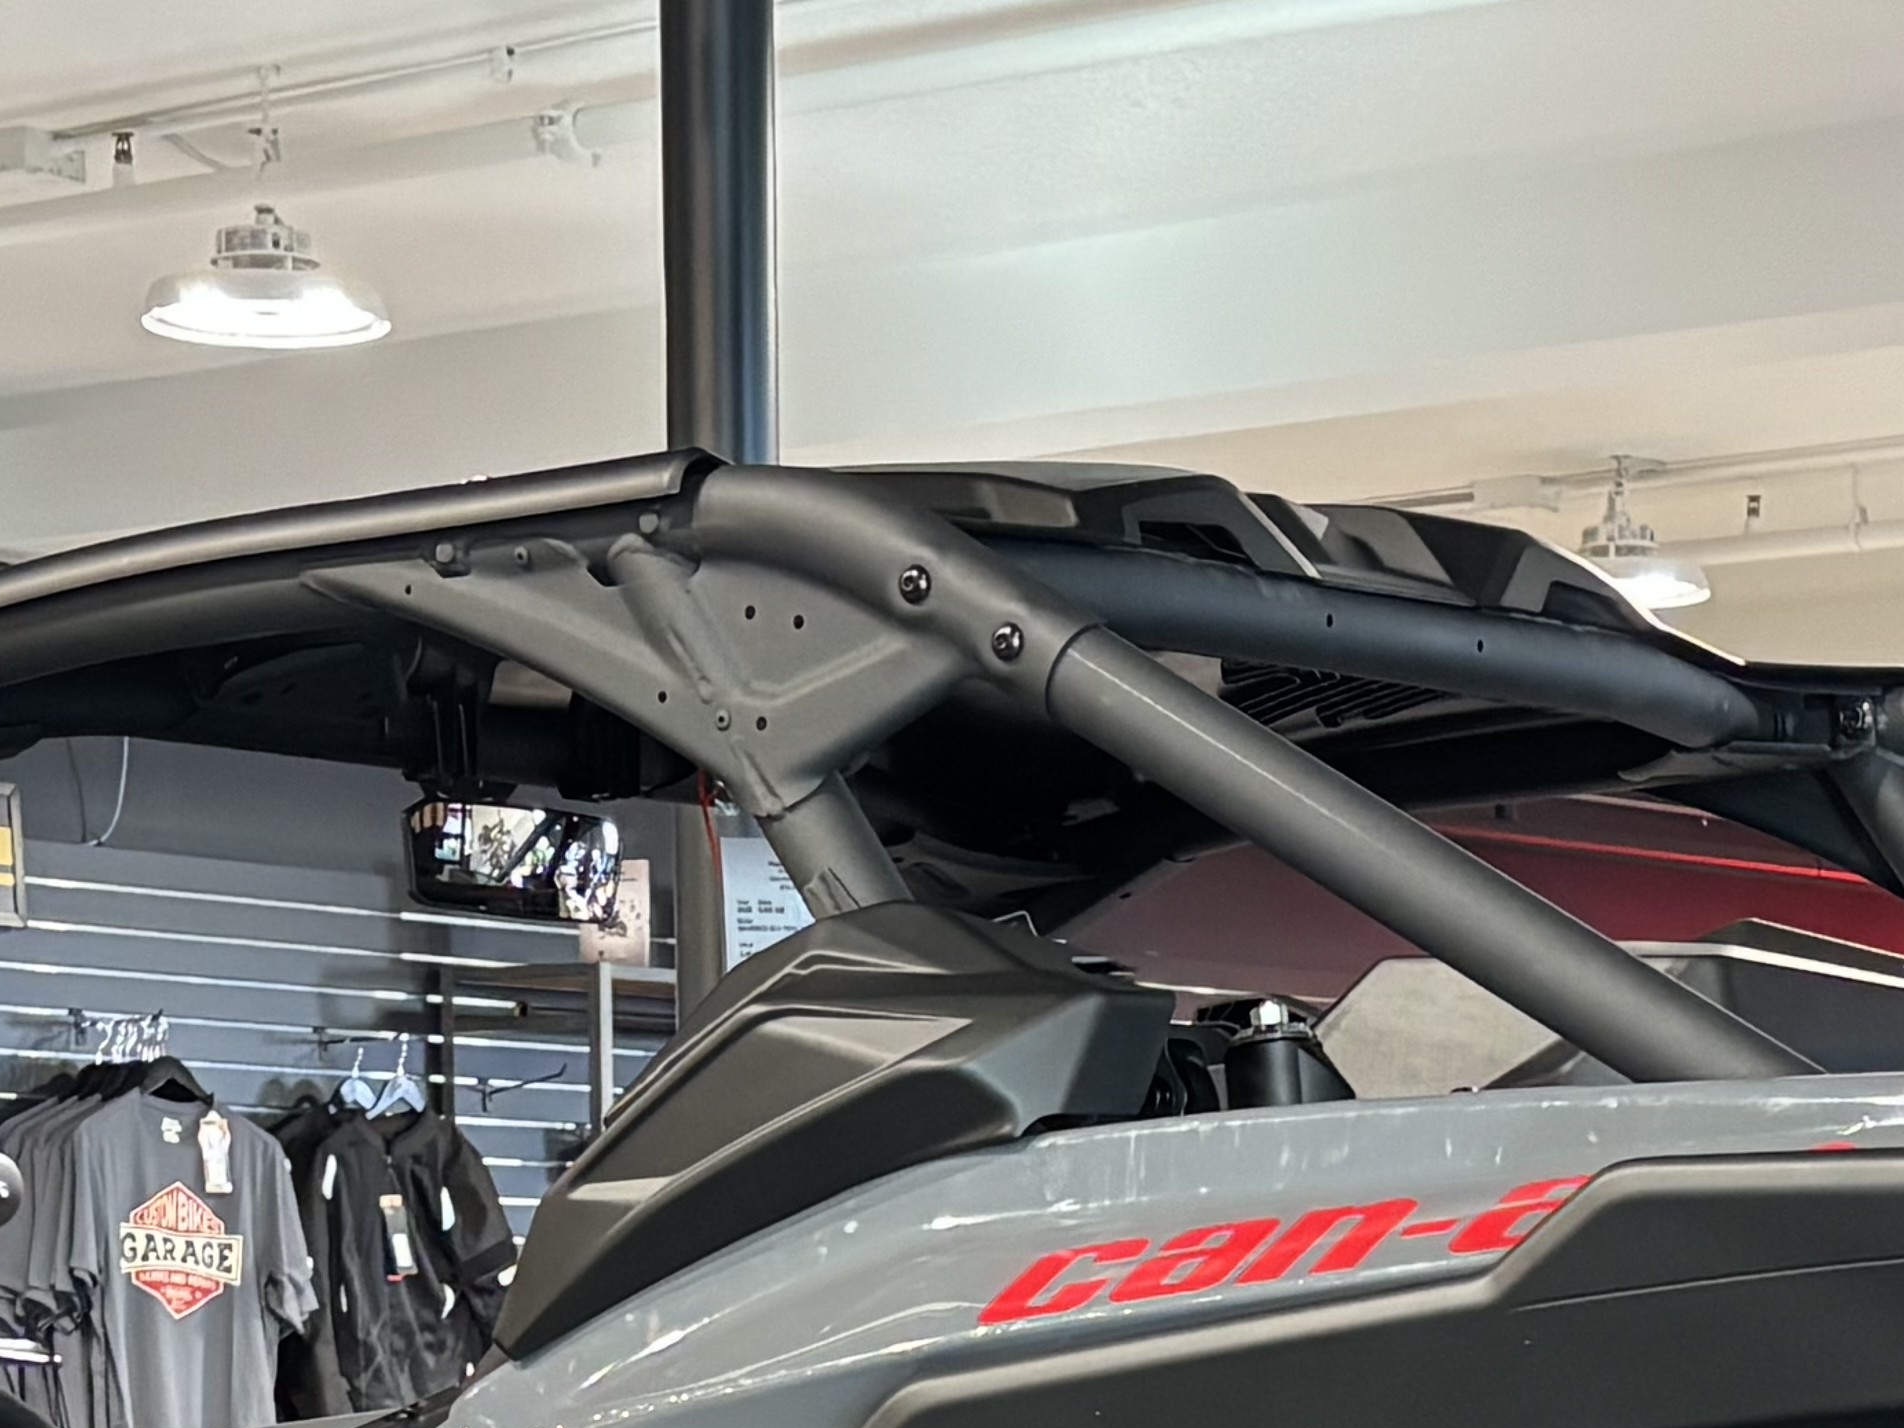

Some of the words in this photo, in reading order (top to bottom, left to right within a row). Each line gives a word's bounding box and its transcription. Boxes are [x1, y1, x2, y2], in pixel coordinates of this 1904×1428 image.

[177, 1189, 221, 1234] BIKES
[122, 1232, 233, 1274] GARAGE
[978, 1174, 1592, 1326] can-a
